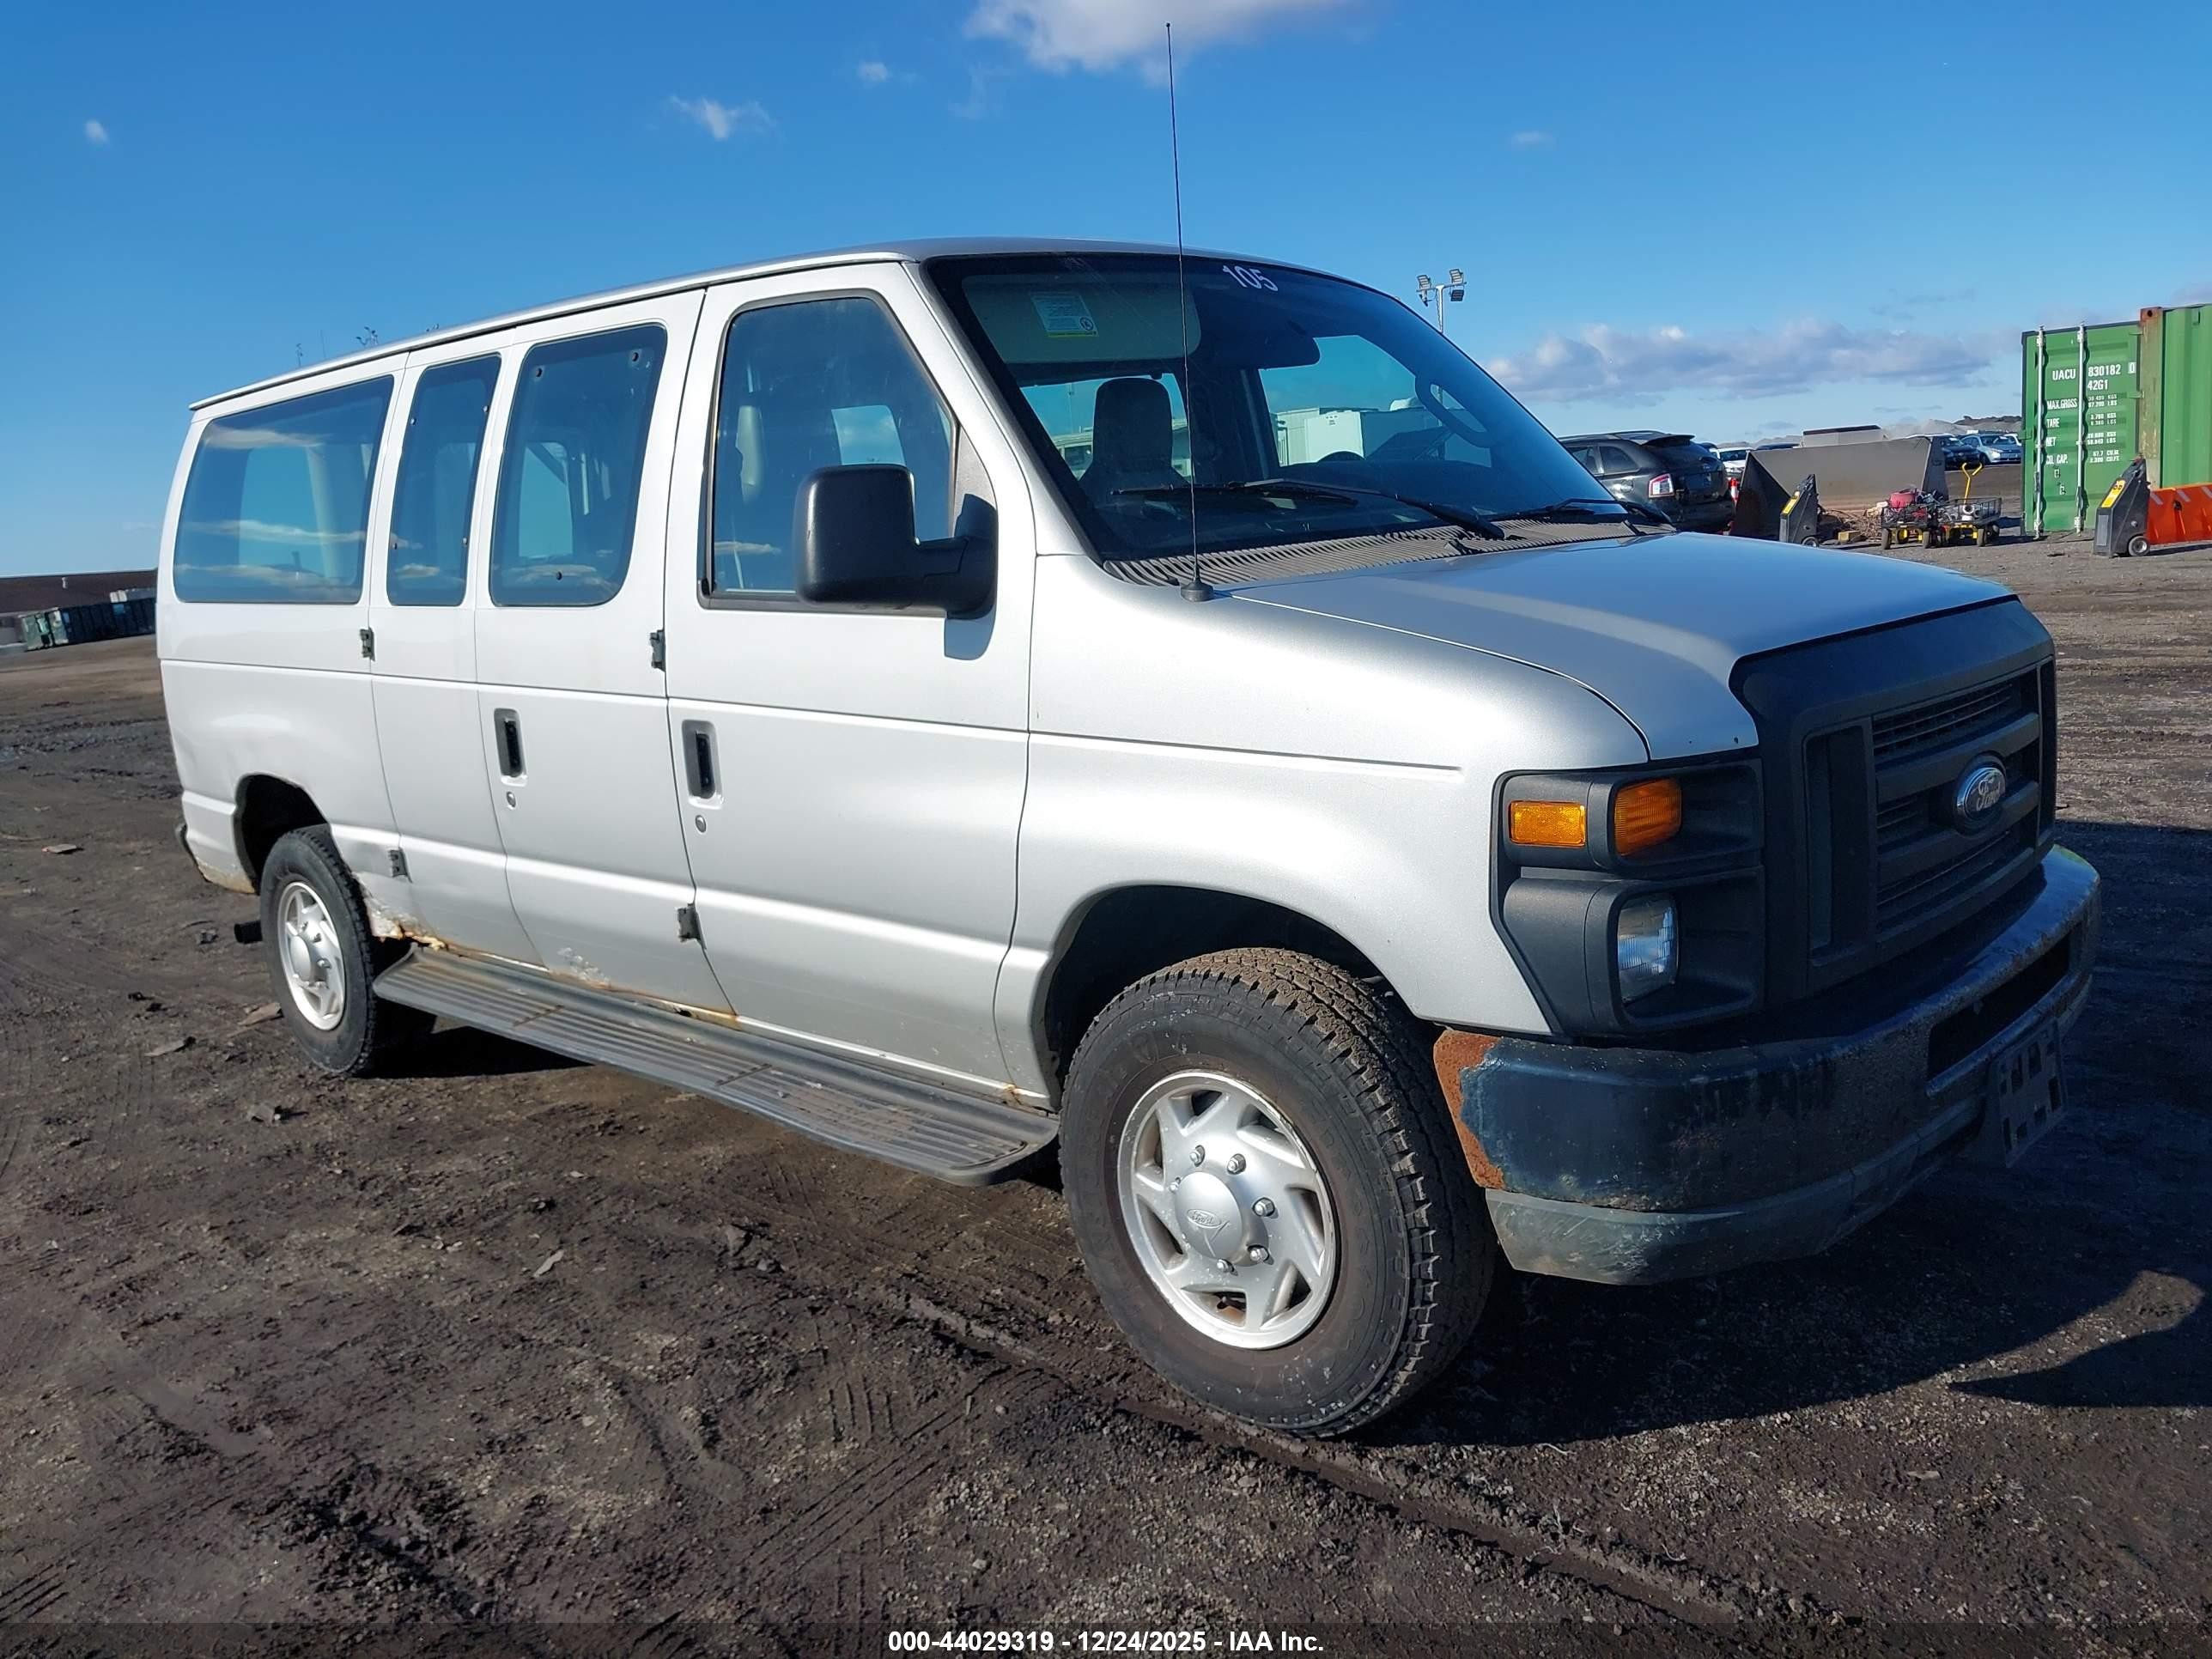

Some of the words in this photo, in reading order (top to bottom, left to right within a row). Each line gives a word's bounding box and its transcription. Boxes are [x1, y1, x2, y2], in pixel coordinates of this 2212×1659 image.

[1222, 265, 1279, 292] 105
[2052, 368, 2076, 380] UACU
[2087, 364, 2121, 377] 830182
[2087, 379, 2109, 391] 42G1
[2046, 418, 2060, 428] TARE
[2045, 436, 2057, 447] NET
